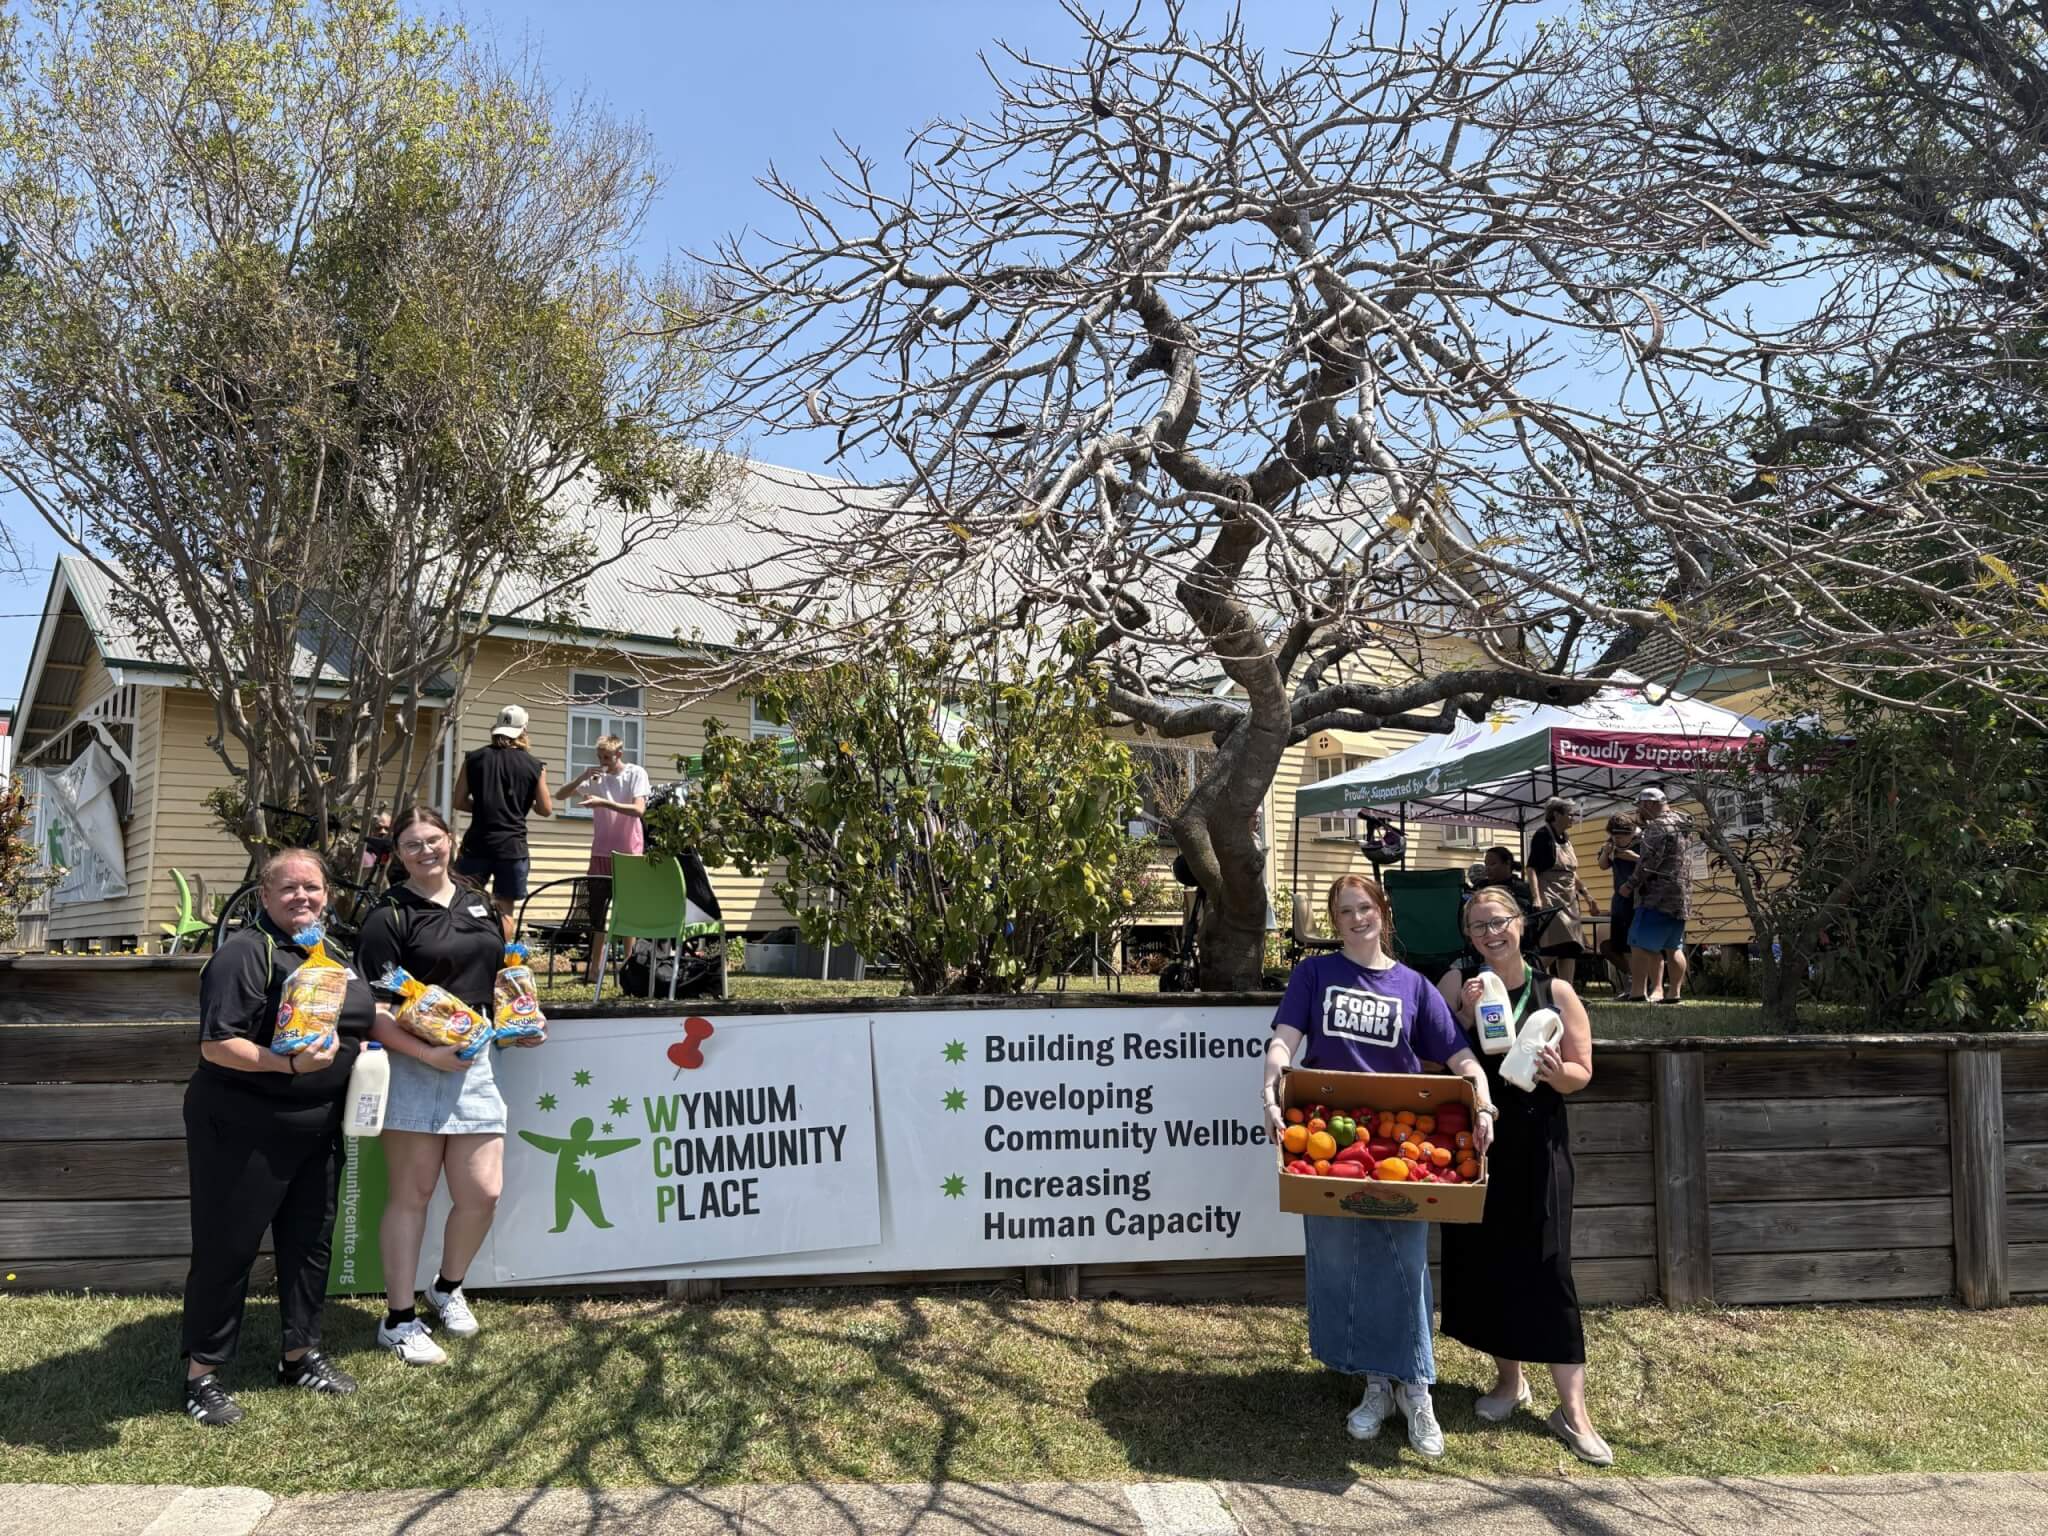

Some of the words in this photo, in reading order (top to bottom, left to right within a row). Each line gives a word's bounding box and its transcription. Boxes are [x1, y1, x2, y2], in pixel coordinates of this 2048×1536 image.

[1559, 739, 1630, 764] Proudly
[1635, 743, 1729, 766] Supported
[1344, 785, 1371, 803] Proudly
[1371, 777, 1412, 801] Supported
[1333, 1009, 1390, 1037] BANK
[1335, 994, 1391, 1018] FOOD
[984, 1033, 1115, 1067] Building
[643, 1084, 796, 1134] WYNNUM
[983, 1082, 1154, 1116] Developing
[652, 1124, 847, 1179] COMMUNITY
[984, 1120, 1158, 1154] Community
[1164, 1118, 1275, 1147] Wellbe
[656, 1177, 760, 1224] PLACE
[984, 1167, 1151, 1201] Increasing
[984, 1211, 1096, 1240] Human
[1105, 1204, 1242, 1241] Capacity
